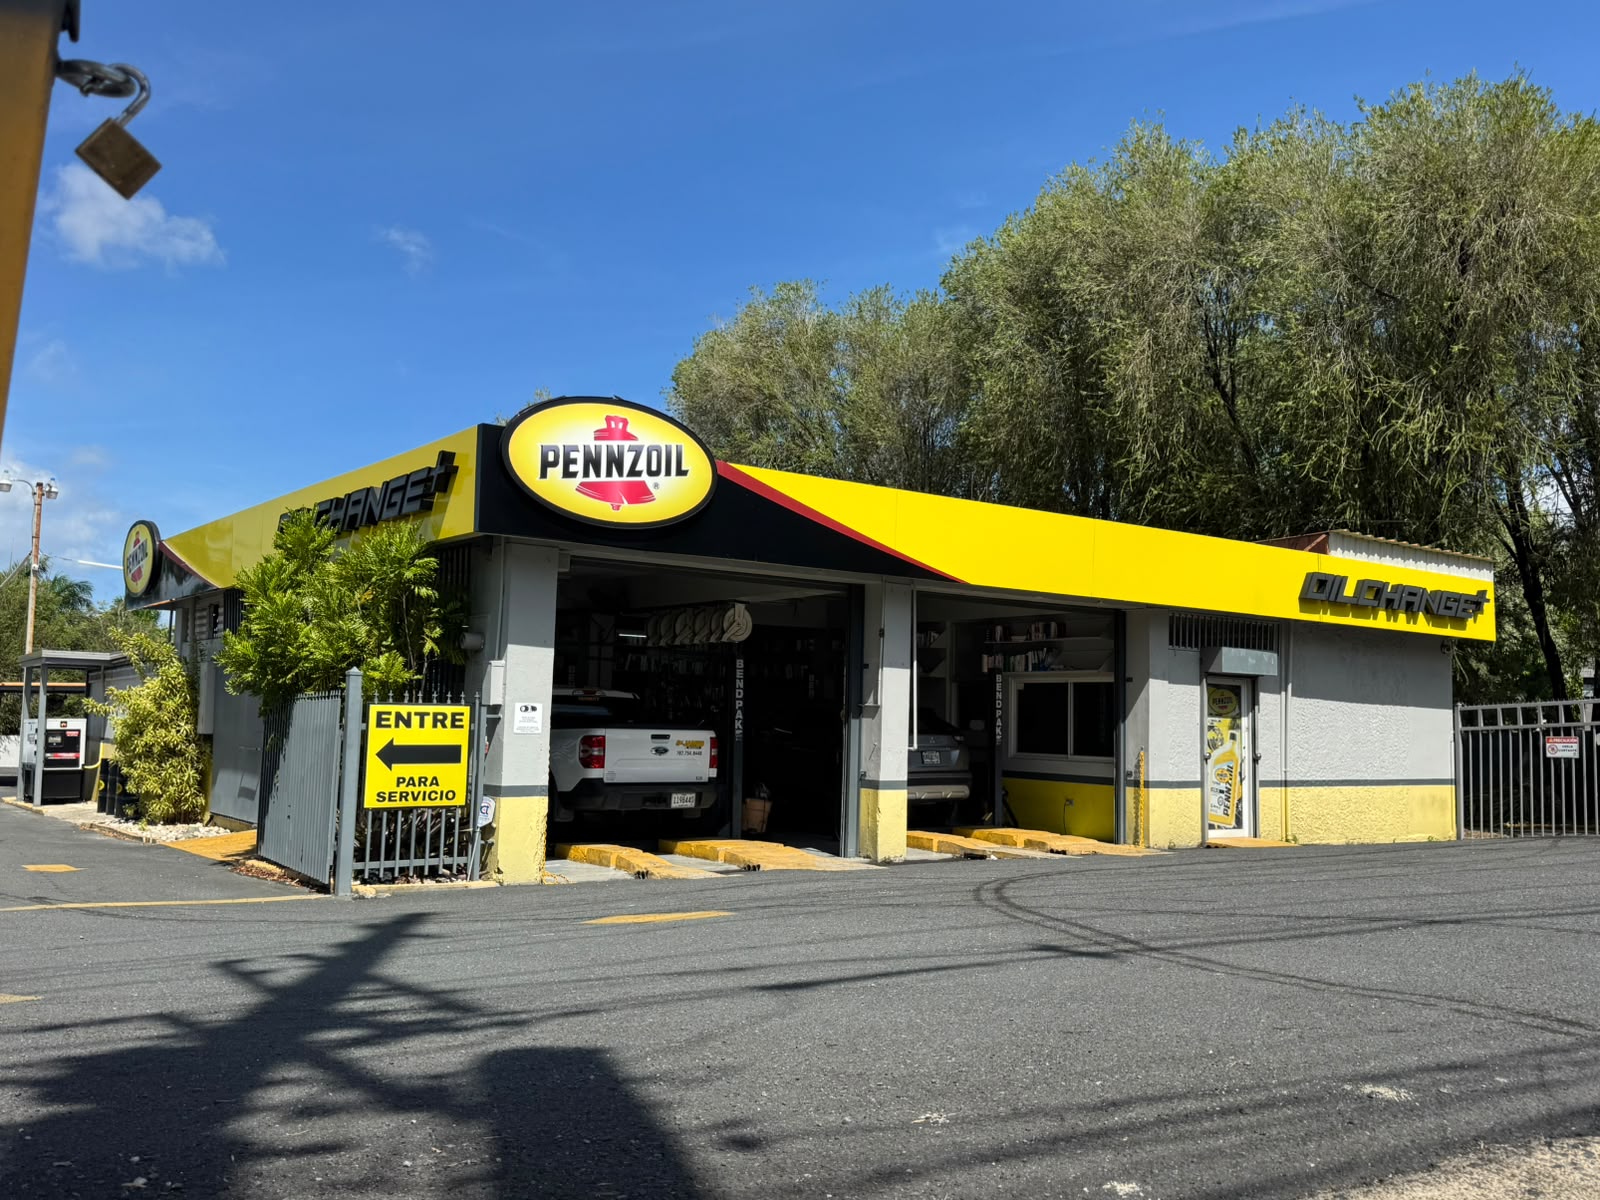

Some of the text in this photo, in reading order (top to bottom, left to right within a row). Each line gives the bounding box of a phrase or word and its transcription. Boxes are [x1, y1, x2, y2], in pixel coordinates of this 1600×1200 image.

[539, 444, 689, 480] PENNZOIL
[375, 711, 465, 729] ENTRE
[396, 776, 440, 788] PARA
[376, 790, 456, 803] SERVICIO
